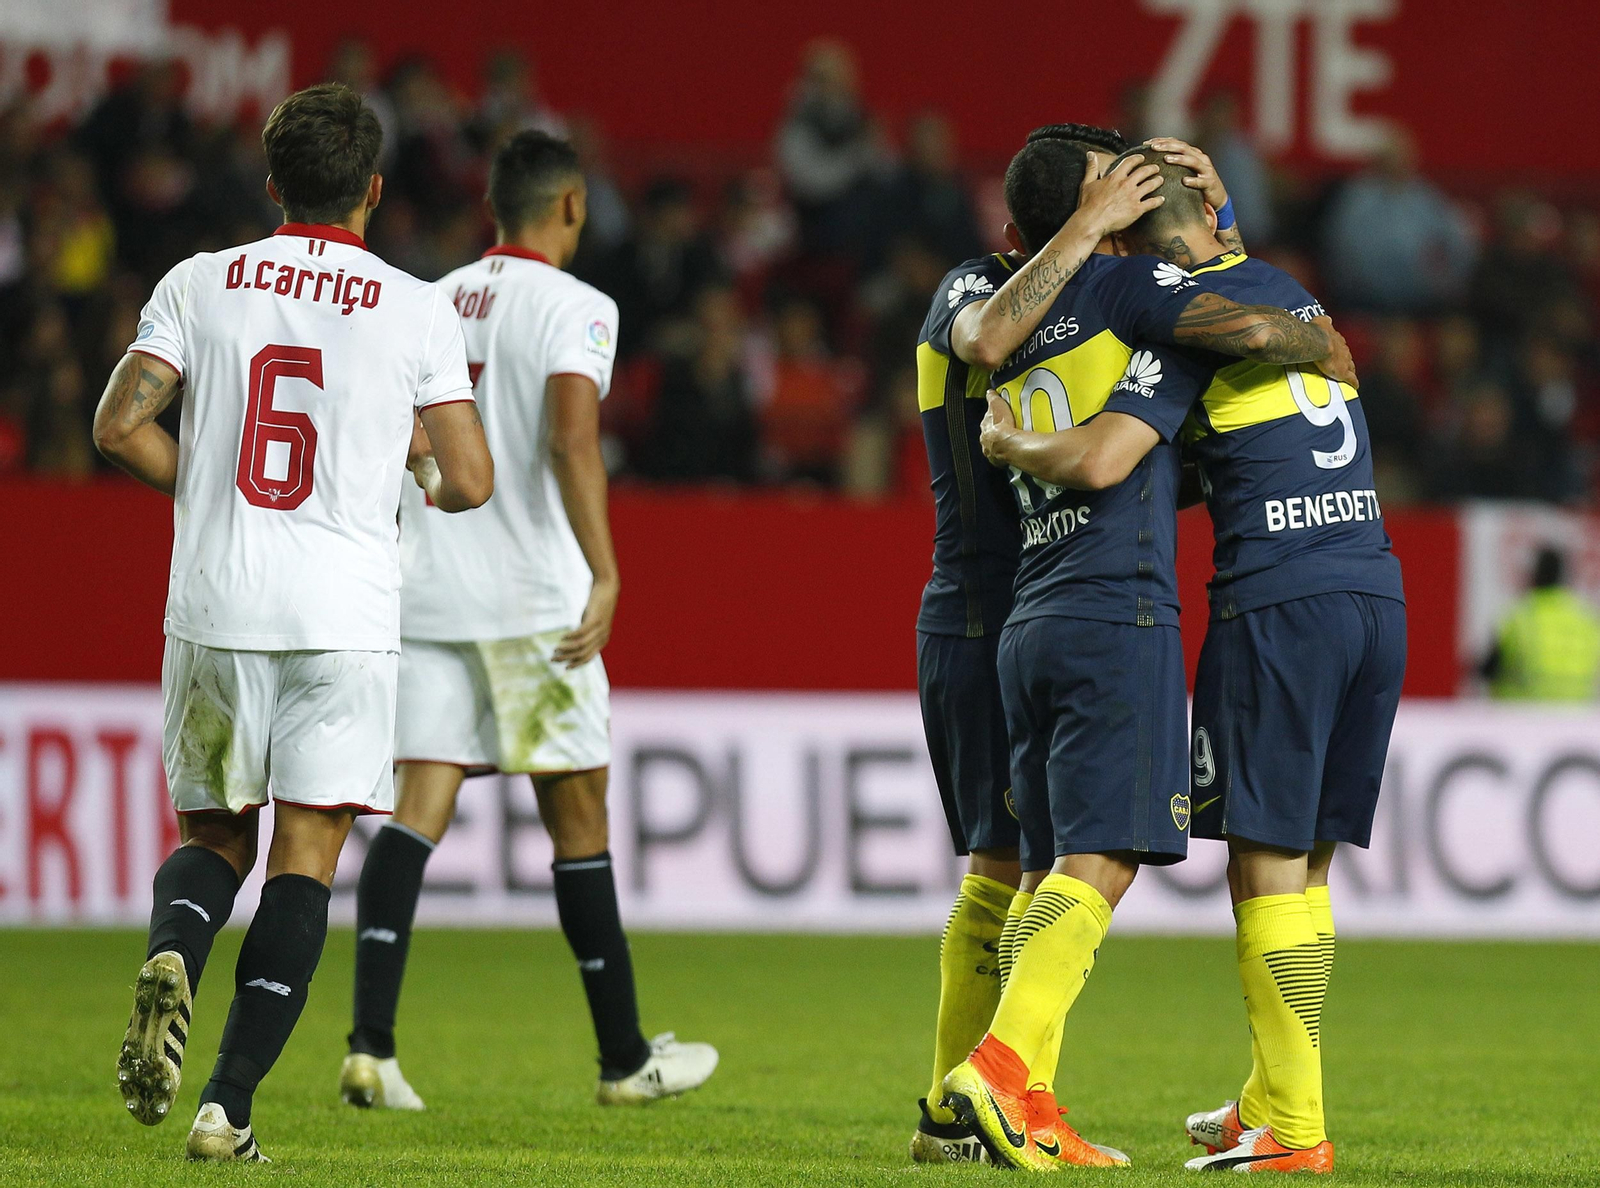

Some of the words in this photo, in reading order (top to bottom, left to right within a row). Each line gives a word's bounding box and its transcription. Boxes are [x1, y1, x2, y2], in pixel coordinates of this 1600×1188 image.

[235, 343, 325, 512] 6
[1284, 364, 1358, 470] 9
[1264, 489, 1382, 533] BENEDETT
[1193, 726, 1216, 787] 9
